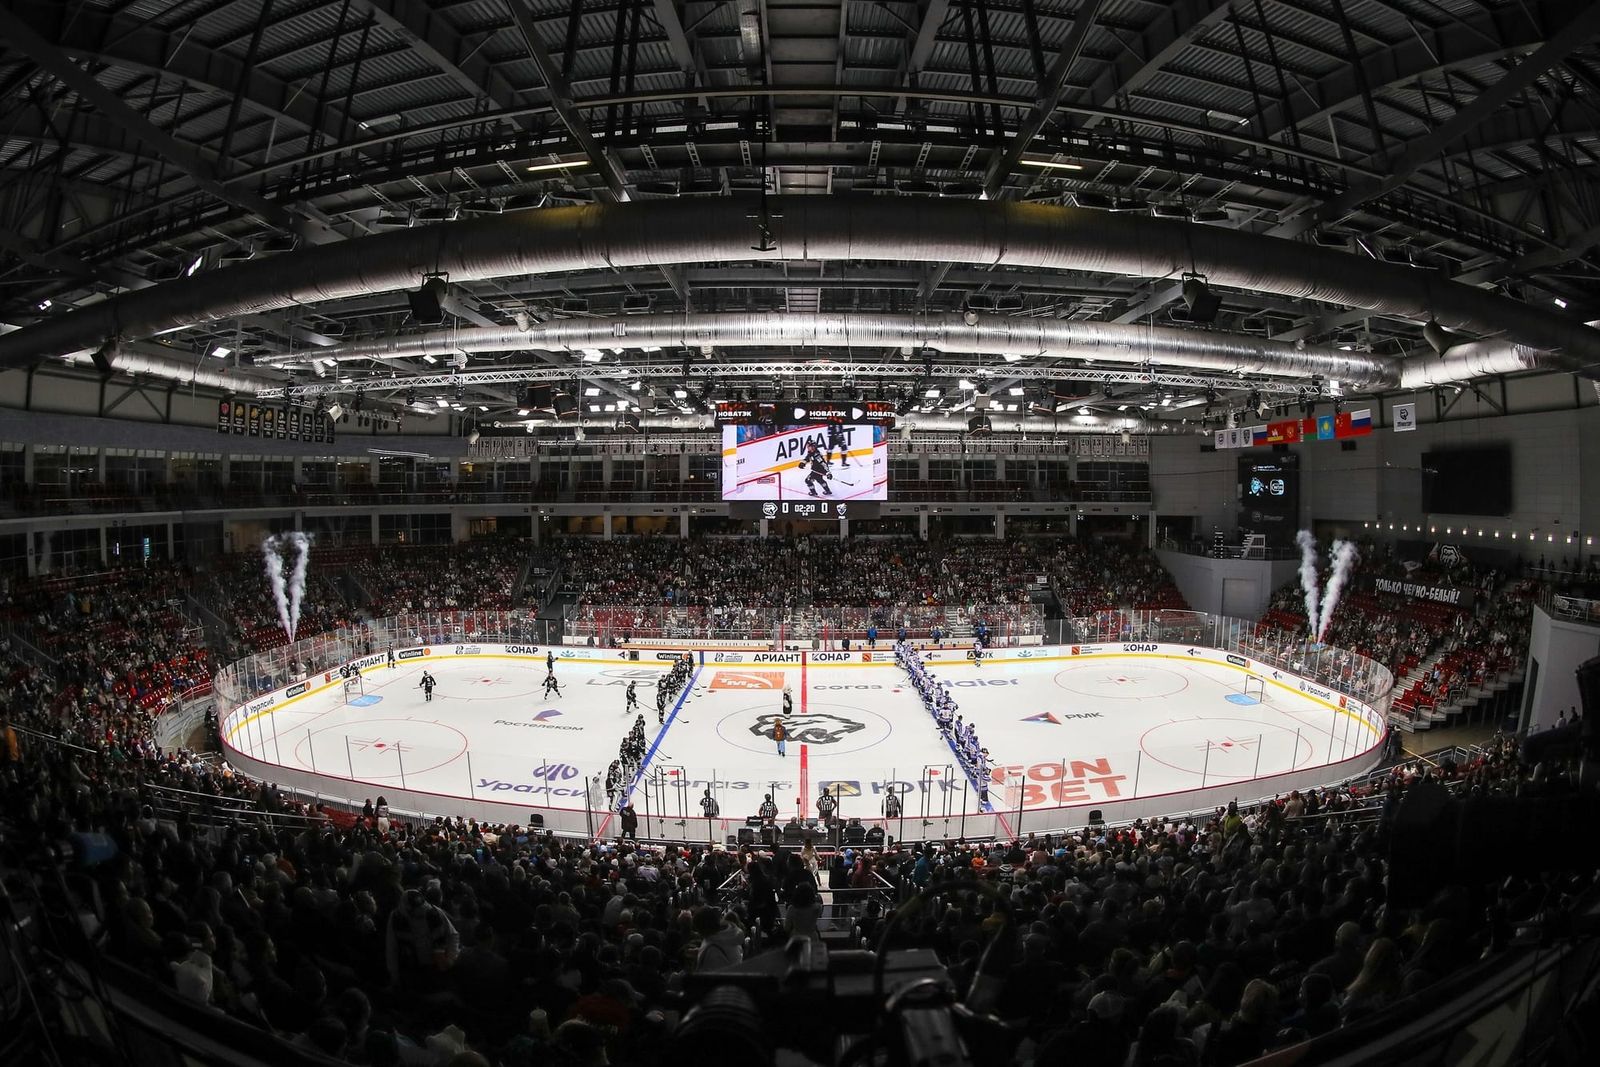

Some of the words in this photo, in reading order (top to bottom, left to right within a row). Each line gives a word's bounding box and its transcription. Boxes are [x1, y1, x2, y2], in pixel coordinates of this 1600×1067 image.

[775, 427, 856, 461] АРИАТ
[782, 502, 789, 514] 0
[794, 504, 816, 513] 02:20
[821, 502, 828, 514] 0
[1375, 579, 1402, 594] ТОЛЬКО
[1403, 583, 1461, 604] ЧЕРНО-БЕЛЫЙ!
[505, 645, 539, 655] КОНАР
[1123, 644, 1158, 653] КОНАР
[400, 650, 423, 659] Winline
[753, 654, 801, 663] АРИАНТ
[812, 653, 851, 662] КОНАР
[586, 679, 658, 687] LAD
[719, 678, 763, 689] ТМК
[1307, 684, 1331, 700] Уралсиб
[249, 697, 275, 713] Уралсиб
[1064, 711, 1105, 721] РМК
[494, 718, 584, 732] Ростелеком
[991, 758, 1113, 785] FON
[476, 778, 587, 798] Уралси
[647, 779, 750, 790] согаз
[872, 777, 963, 794] ЮГК
